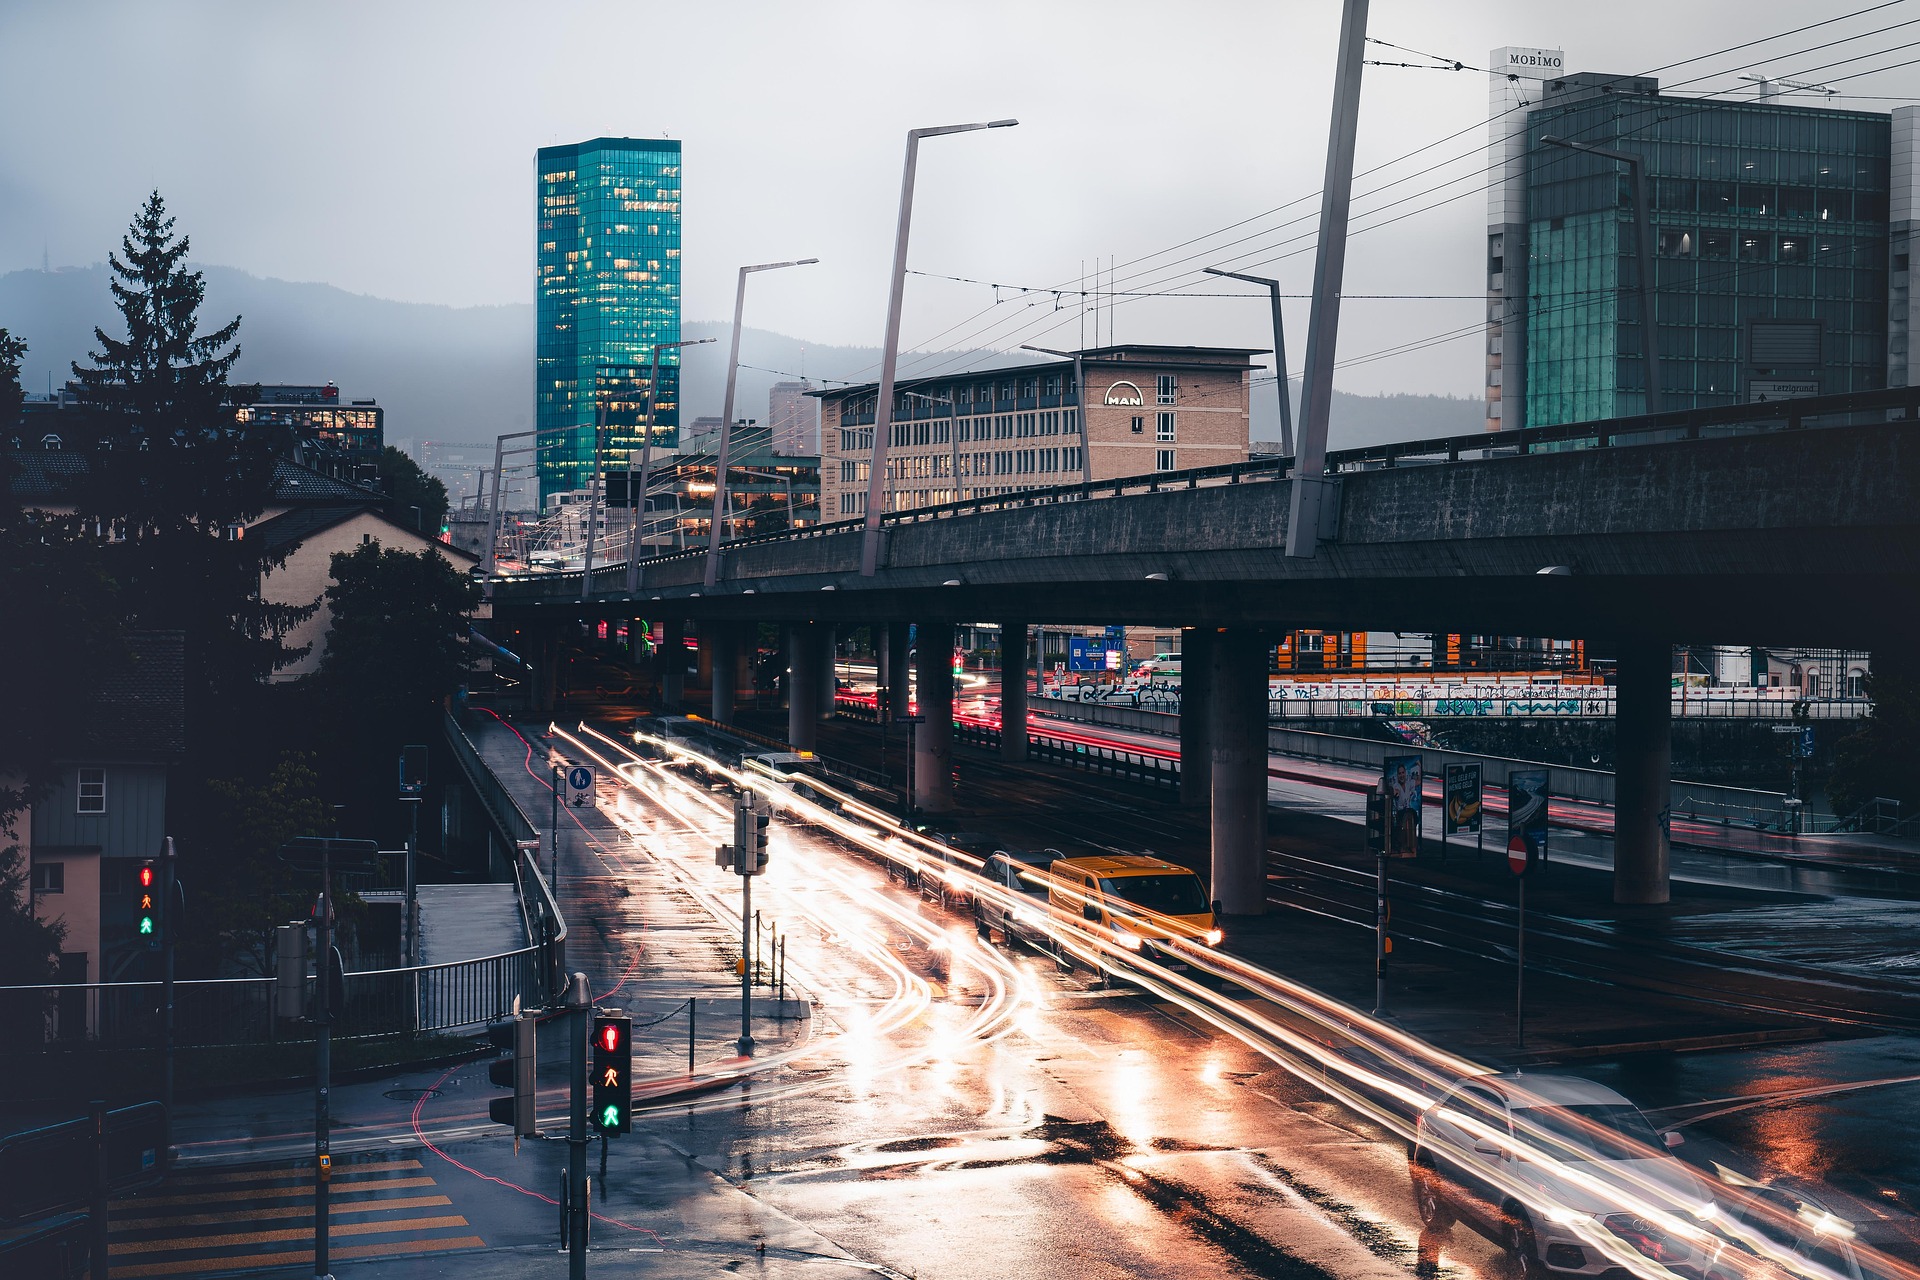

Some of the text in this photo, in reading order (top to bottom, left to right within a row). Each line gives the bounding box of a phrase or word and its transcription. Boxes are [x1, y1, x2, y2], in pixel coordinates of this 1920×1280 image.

[1510, 52, 1561, 67] MOBIMO
[1773, 384, 1814, 394] Letzigrund
[1108, 397, 1141, 406] MAN
